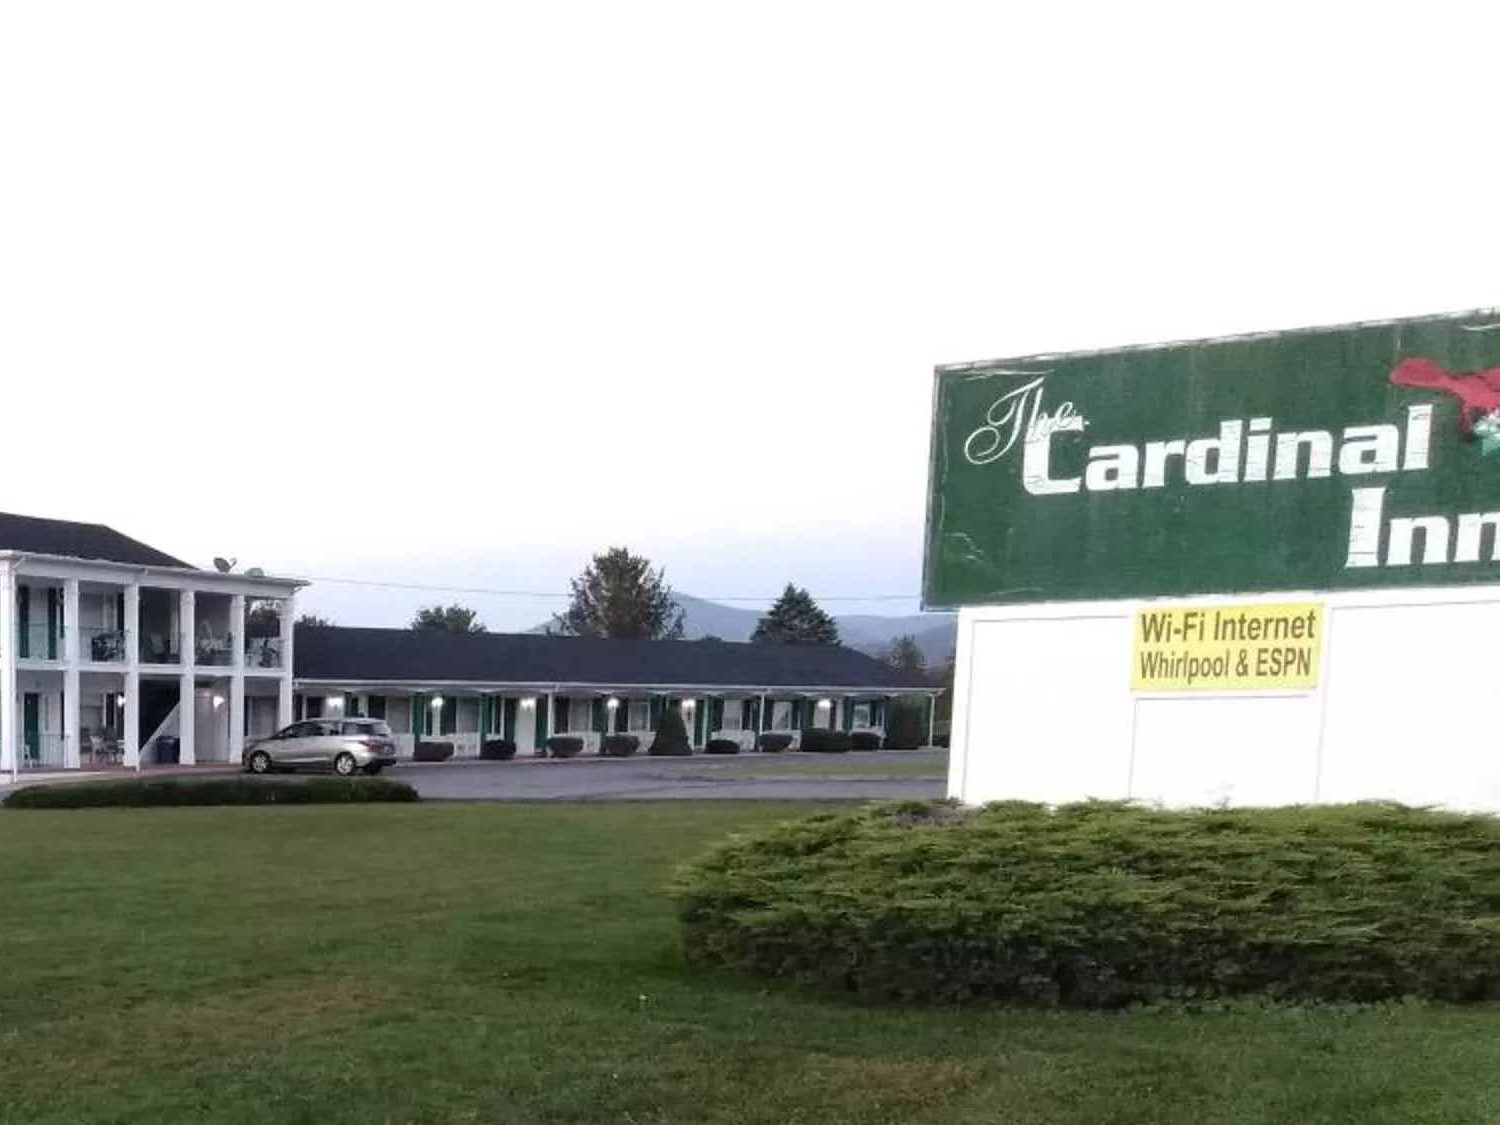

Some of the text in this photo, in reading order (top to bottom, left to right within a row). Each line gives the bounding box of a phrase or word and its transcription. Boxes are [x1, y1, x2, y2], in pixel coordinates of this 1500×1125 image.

[964, 376, 1090, 465] The
[1023, 404, 1434, 495] Cardinal
[1344, 486, 1500, 568] Inn
[1140, 608, 1316, 643] Wi-Fi Internet
[1140, 648, 1311, 685] Whirlpool & ESPN
